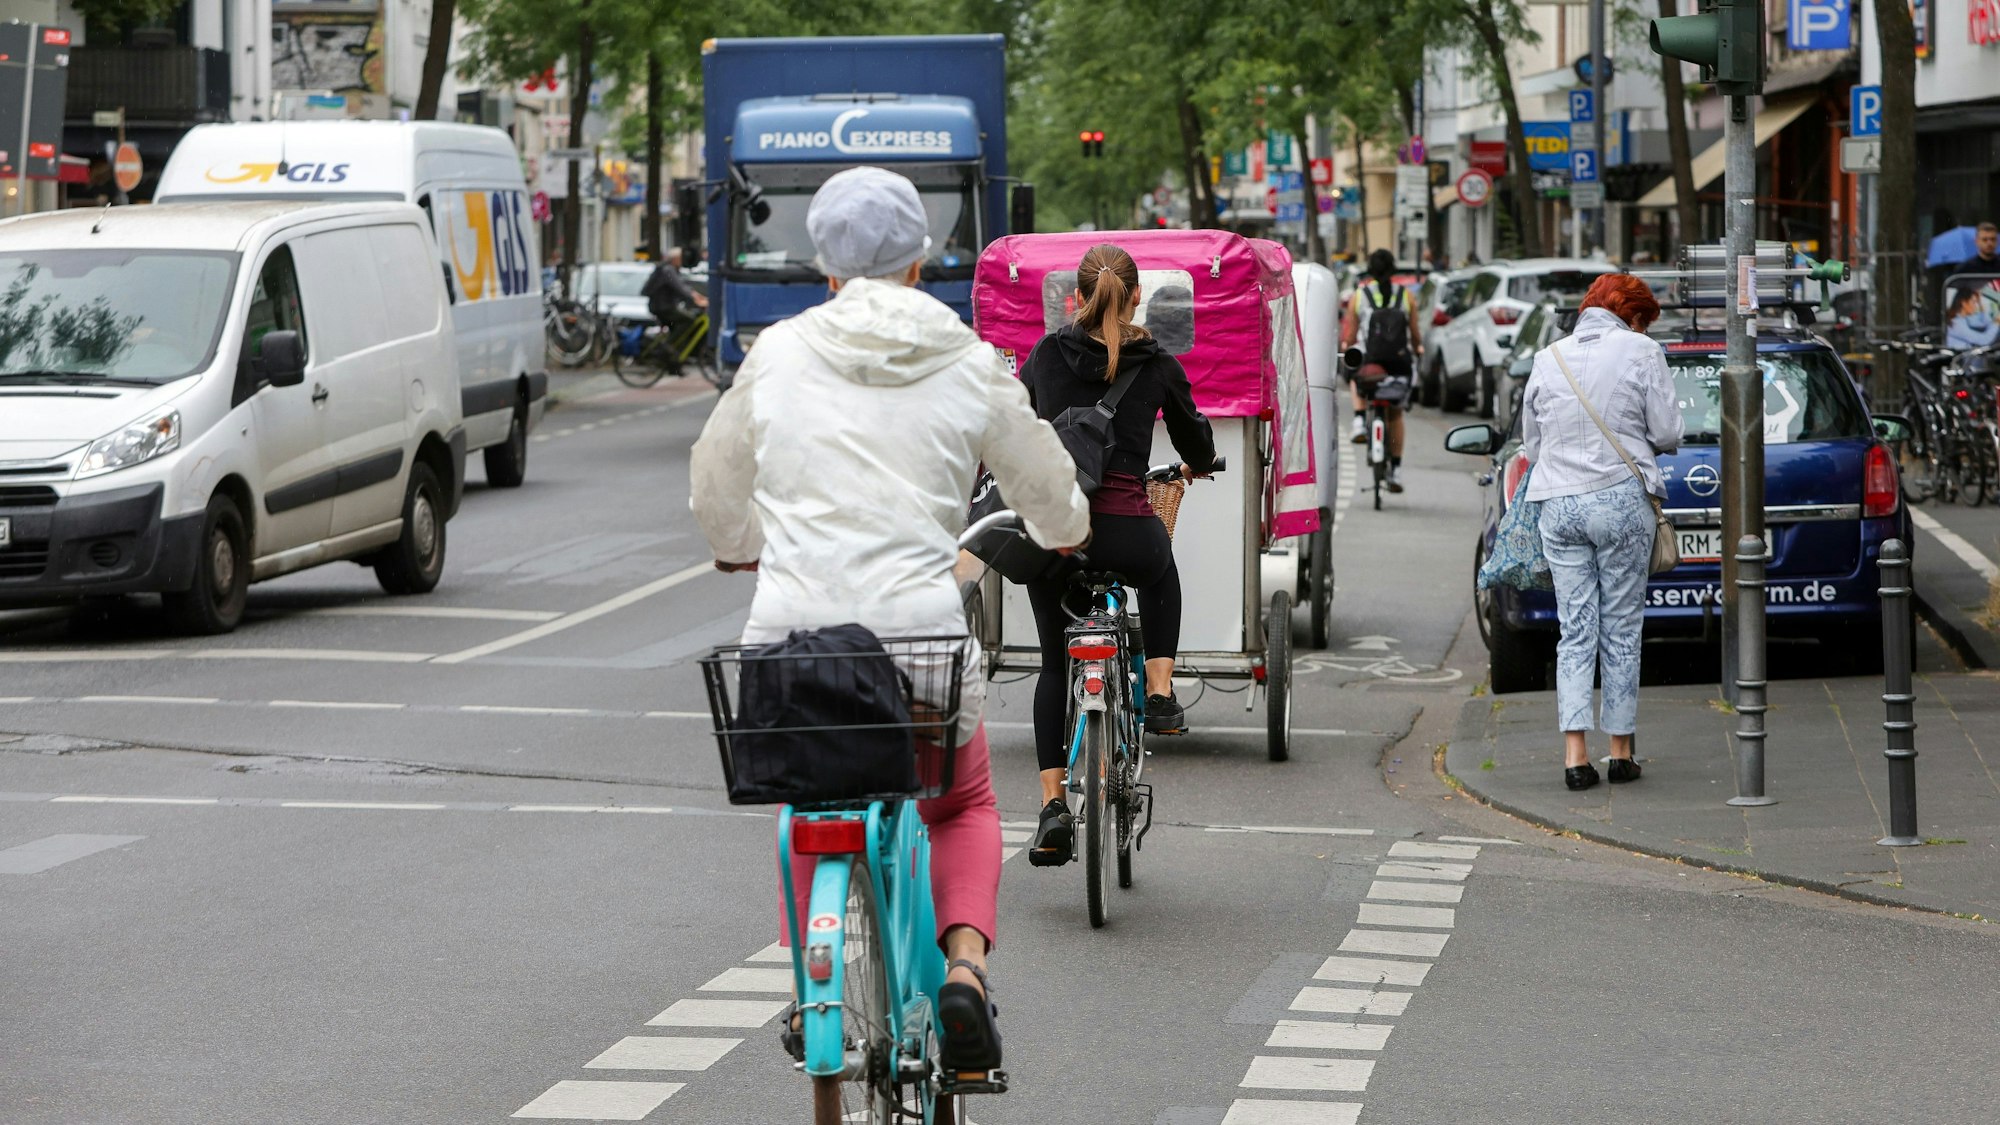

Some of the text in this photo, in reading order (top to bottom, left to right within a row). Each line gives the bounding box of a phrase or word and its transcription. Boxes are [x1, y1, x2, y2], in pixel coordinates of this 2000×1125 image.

[1572, 93, 1588, 119] P
[1859, 91, 1881, 131] P
[851, 131, 952, 147] EXPRESS
[287, 163, 350, 183] GLS
[1574, 152, 1590, 179] P
[1464, 179, 1485, 196] 30
[492, 190, 529, 296] GLS
[1682, 534, 1710, 554] RM
